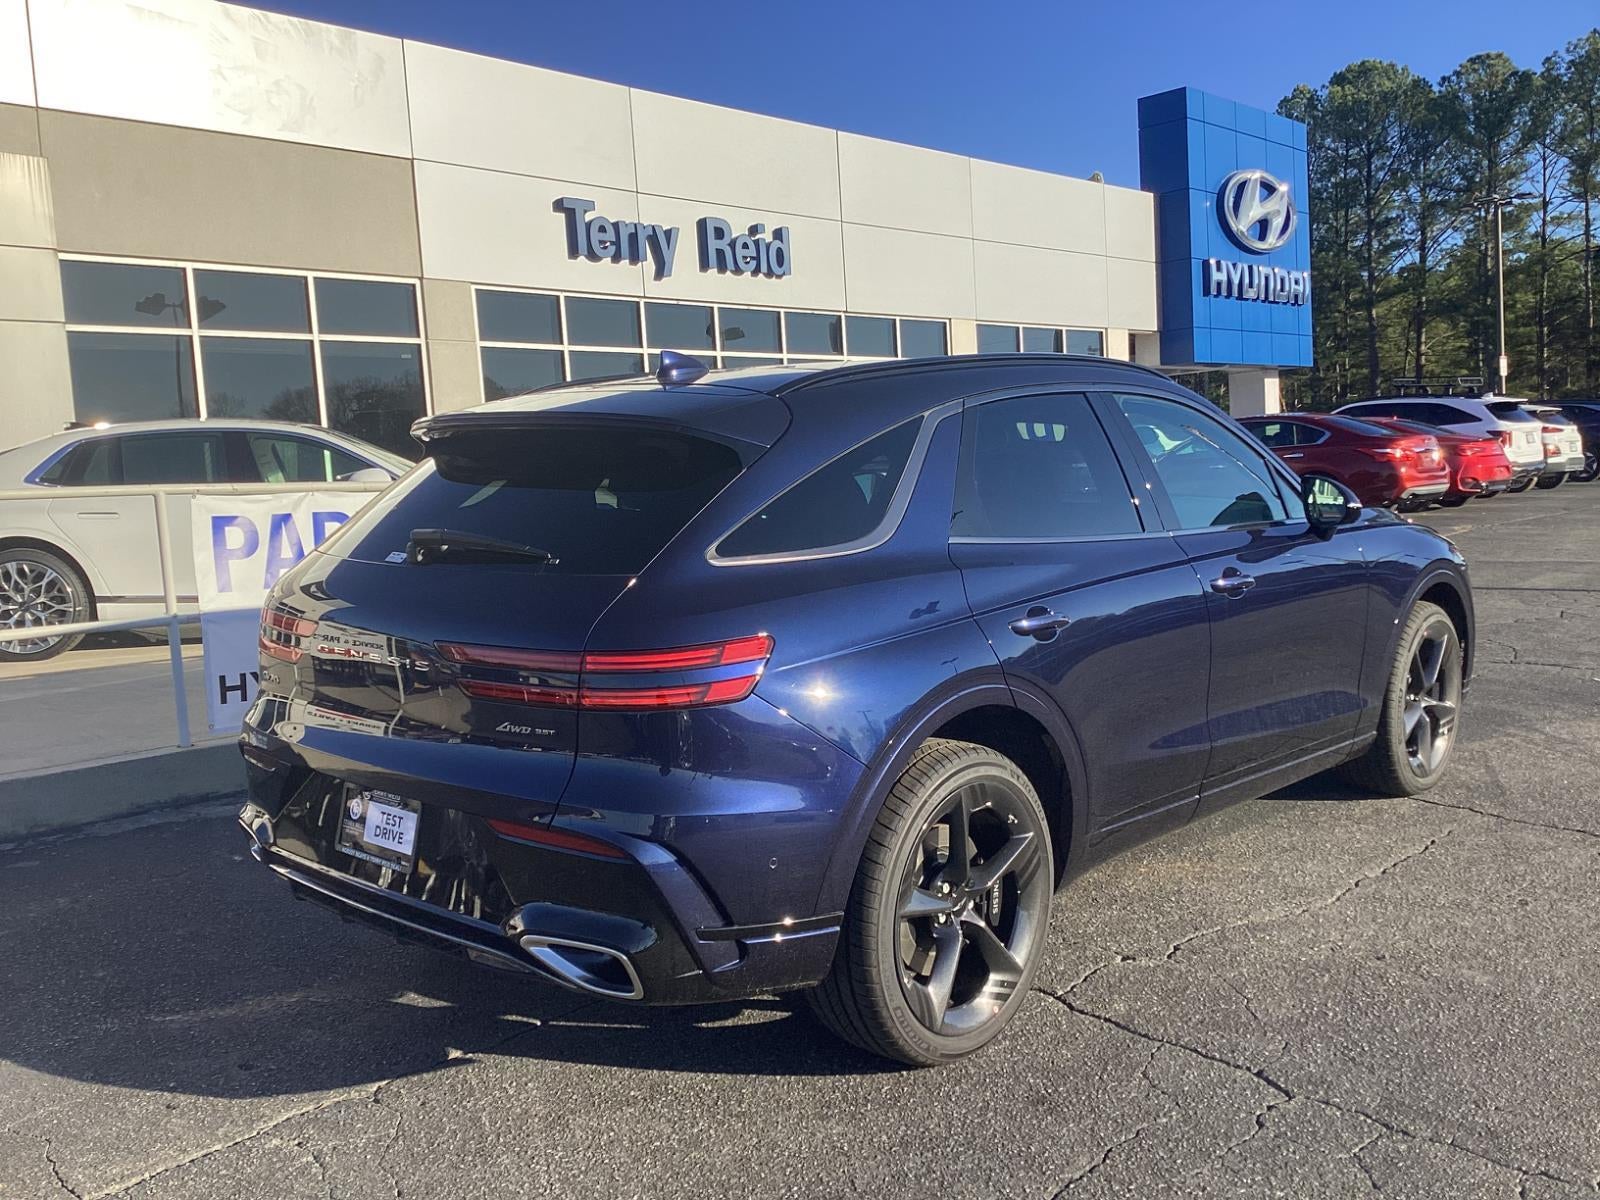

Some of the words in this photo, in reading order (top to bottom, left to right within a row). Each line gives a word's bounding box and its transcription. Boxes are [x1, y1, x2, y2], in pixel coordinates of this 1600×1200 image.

[552, 197, 680, 281] Terry
[696, 217, 792, 280] Reid
[1203, 259, 1311, 305] HYUNDAI
[317, 644, 430, 672] GENESIS
[380, 811, 404, 828] TEST
[374, 825, 404, 845] DRIVE
